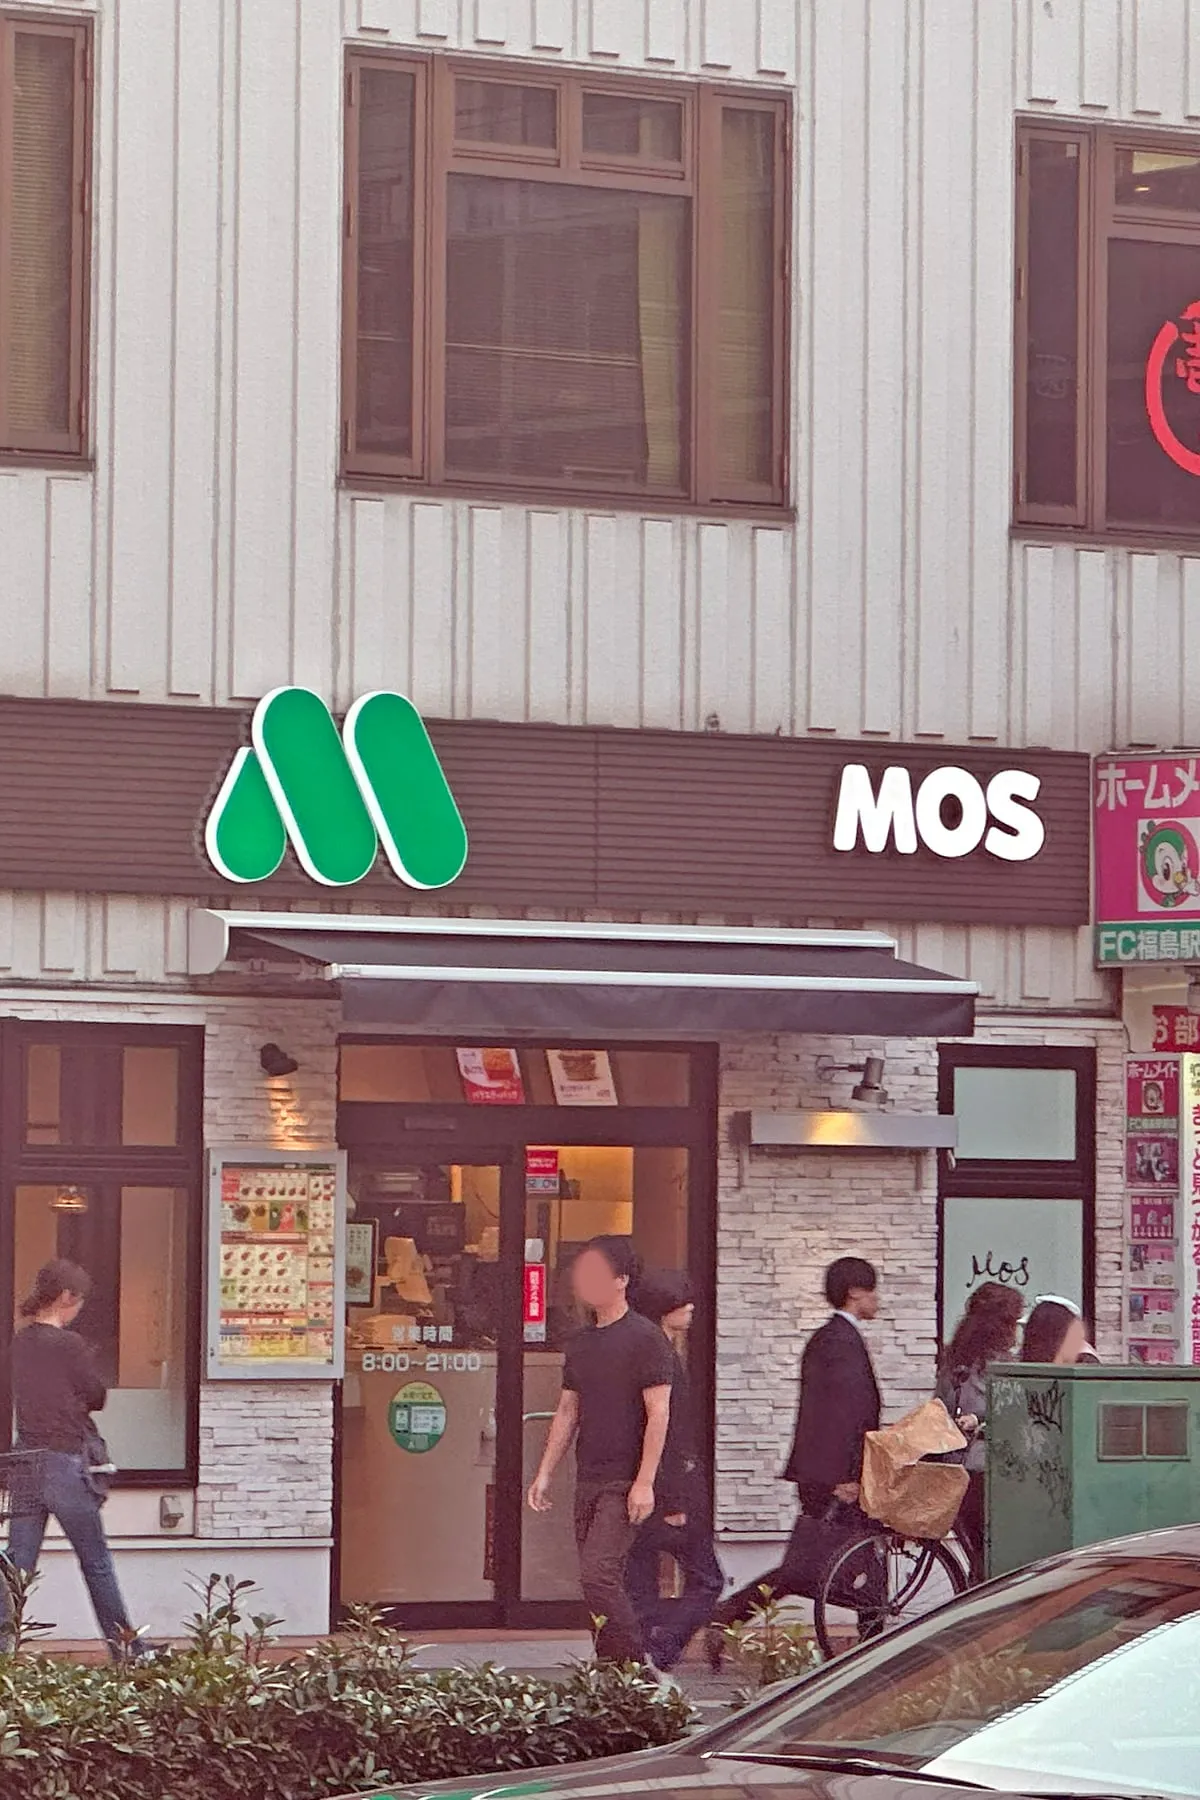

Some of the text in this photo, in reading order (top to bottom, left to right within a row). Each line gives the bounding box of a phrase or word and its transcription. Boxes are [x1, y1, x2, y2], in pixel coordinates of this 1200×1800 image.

[833, 764, 1045, 861] MOS
[1127, 1062, 1178, 1079] ホームメイト
